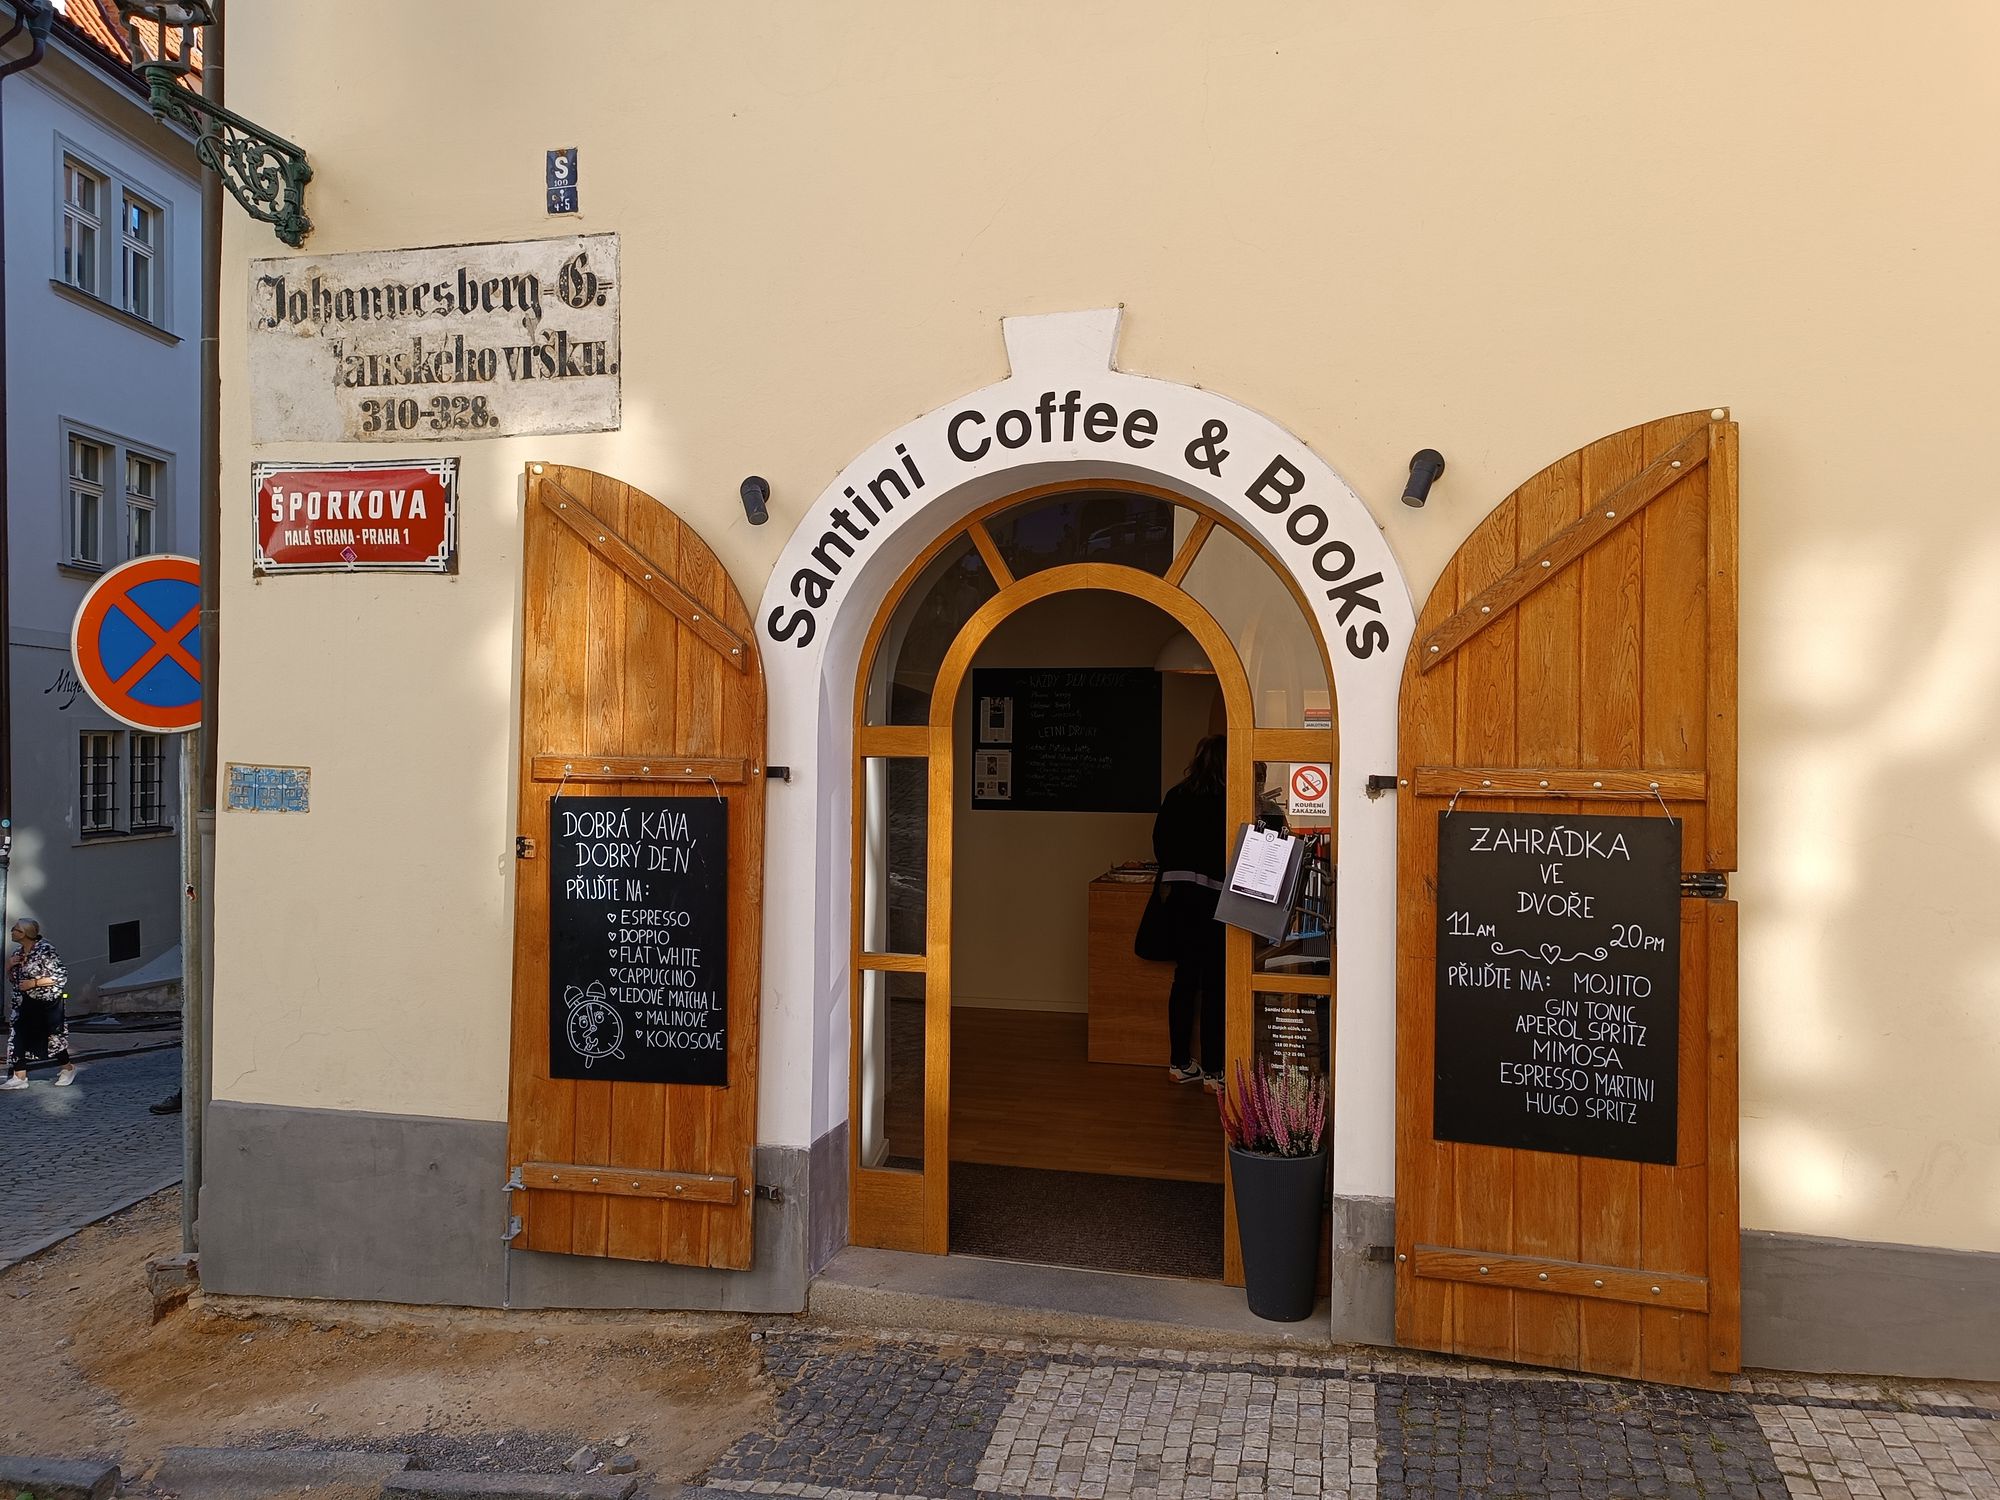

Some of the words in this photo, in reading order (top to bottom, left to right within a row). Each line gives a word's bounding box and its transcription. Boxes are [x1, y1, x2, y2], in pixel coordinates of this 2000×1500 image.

[555, 156, 568, 179] S
[271, 486, 427, 522] ŠPORKOVA
[284, 525, 311, 546] MALÁ
[314, 529, 355, 545] STRANA
[362, 528, 400, 545] PRAHA
[403, 528, 409, 544] 1
[767, 443, 925, 648] Santini
[947, 390, 1158, 462] Coffee
[1184, 419, 1230, 478] &
[1244, 453, 1390, 660] Books
[562, 808, 631, 838] DOBRÁ
[576, 840, 642, 868] DOBRÝ
[1469, 825, 1630, 861] ZAHRÁDKA
[1540, 863, 1564, 884] VE
[566, 875, 620, 901] PŘIJĎTE
[626, 879, 650, 902] NA:
[621, 909, 690, 927] ESPRESSO
[1516, 891, 1595, 918] DVOŘE
[619, 929, 670, 945] DOPPIO
[620, 946, 653, 964] FLAT
[656, 946, 701, 968] WHITE
[618, 968, 696, 988] CAPPUCCINO
[1448, 961, 1512, 990] PŘIJĎTE
[1520, 969, 1551, 992] NA:
[1573, 972, 1652, 998] MOJITO
[618, 987, 665, 1006] LEDOVÉ
[668, 990, 709, 1010] MATCHA
[1544, 998, 1578, 1017] GIN
[1584, 1001, 1637, 1024] TONIC
[646, 1010, 709, 1028] MALINOVÉ
[1515, 1014, 1583, 1040] APEROL
[1588, 1021, 1647, 1047] SPRITZ
[646, 1029, 725, 1050] KOKOSOVÉ
[1533, 1039, 1623, 1070] MIMOSA
[1500, 1062, 1589, 1091] ESPRESSO
[1595, 1072, 1655, 1103] MARTINI
[1525, 1091, 1579, 1117] HUGO
[1585, 1097, 1637, 1125] SPRITZ
